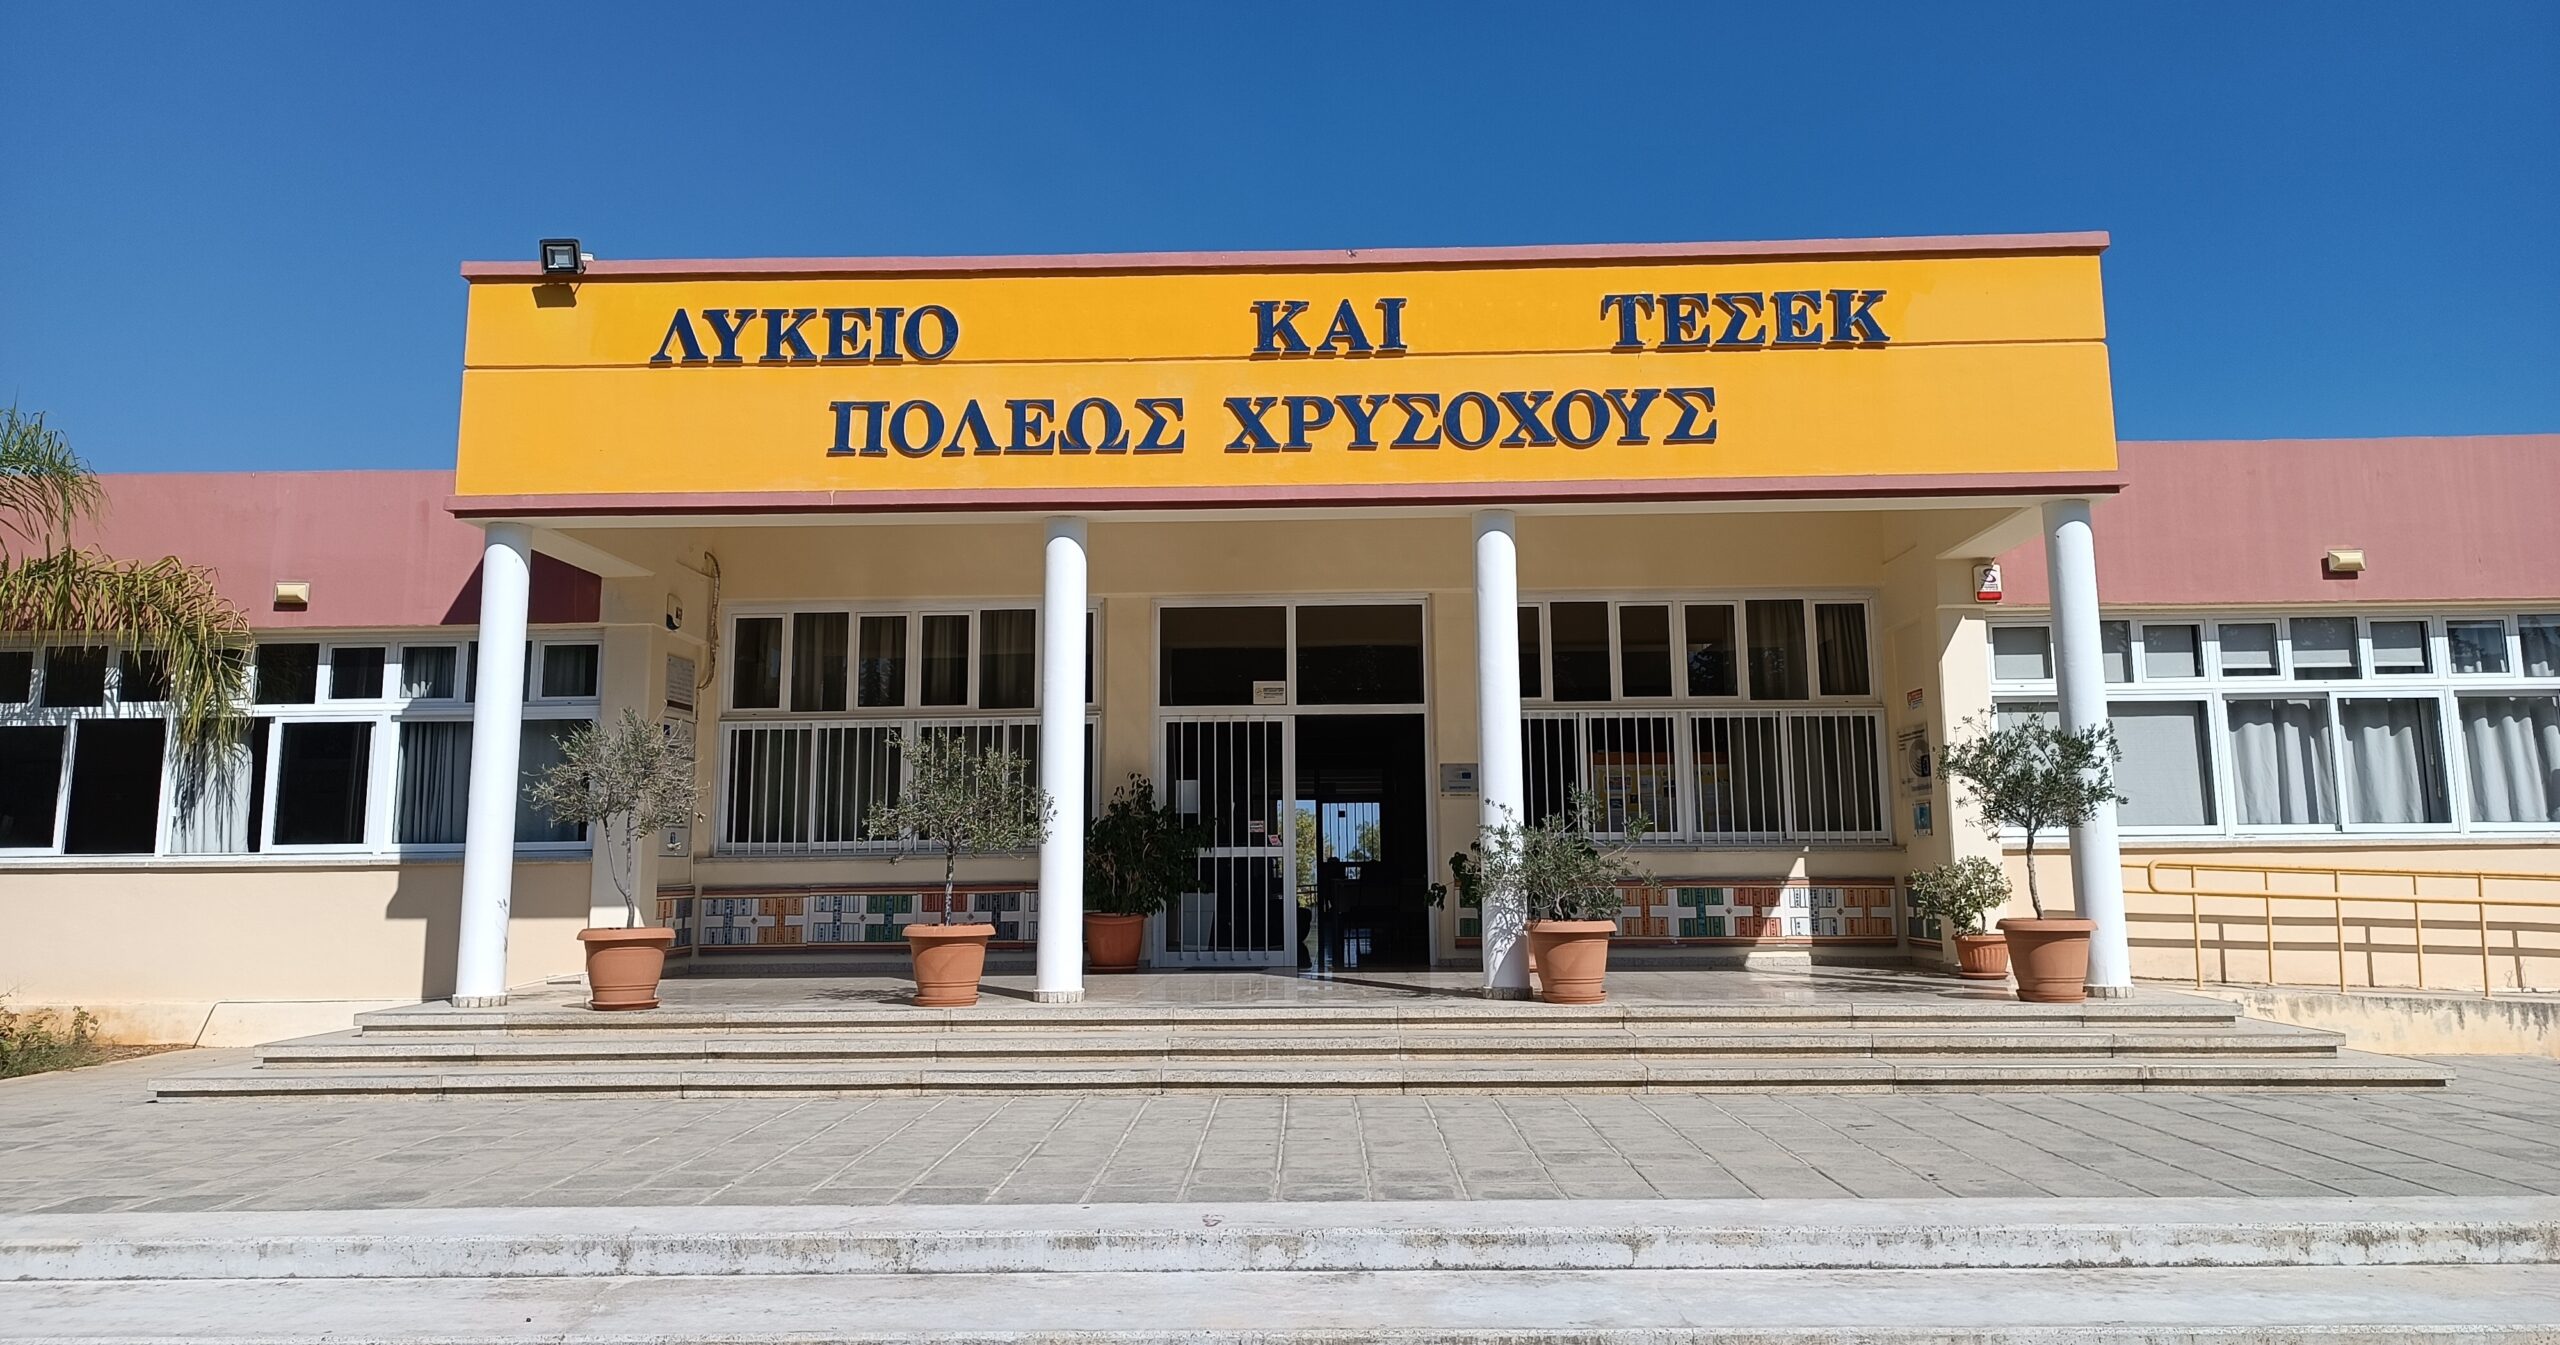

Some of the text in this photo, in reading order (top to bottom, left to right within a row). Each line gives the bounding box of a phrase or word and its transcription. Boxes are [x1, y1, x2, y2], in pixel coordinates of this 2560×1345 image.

[650, 289, 1891, 365] ΛΥΚΕΙΟ ΚΑΙ ΤΕΣΕΚ
[828, 387, 1717, 457] ΠΟΛΕΩΣ ΧΡΥΣΟΧΟΥΣ
